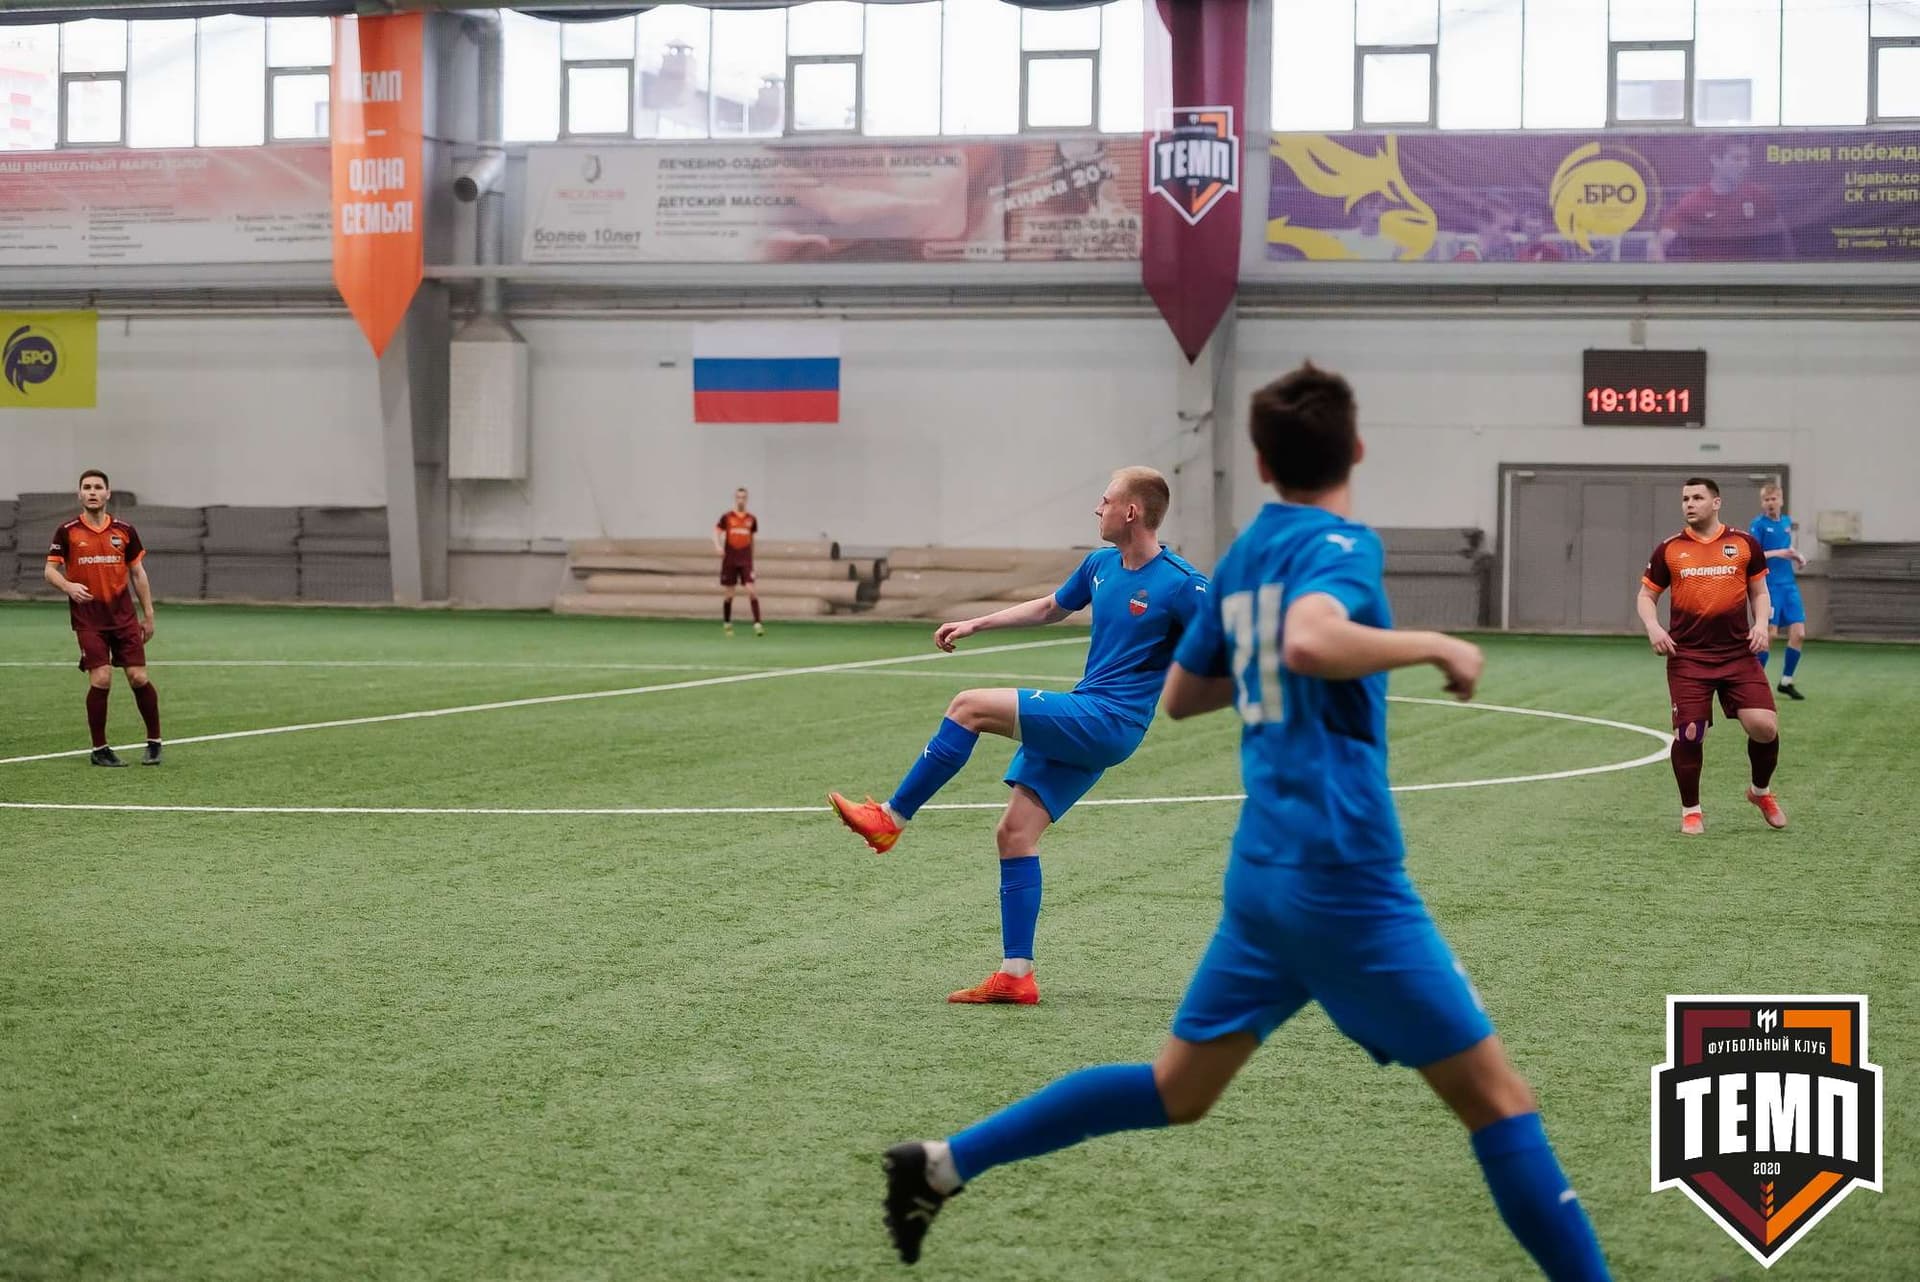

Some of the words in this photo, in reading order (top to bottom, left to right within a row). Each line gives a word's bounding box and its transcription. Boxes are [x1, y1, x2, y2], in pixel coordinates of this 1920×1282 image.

[1157, 139, 1230, 181] ТЕМП
[1767, 145, 1831, 165] Время
[1838, 142, 1920, 162] побежд
[349, 157, 405, 195] ОДНА
[658, 195, 726, 208] ДЕТСКИЙ
[1577, 183, 1638, 204] .БРО
[342, 200, 413, 235] СЕМЬЯ!
[534, 228, 587, 243] более
[594, 228, 642, 243] 10лет
[17, 350, 53, 365] .БРО
[1586, 387, 1690, 413] 19:18:11
[1221, 582, 1285, 723] 21
